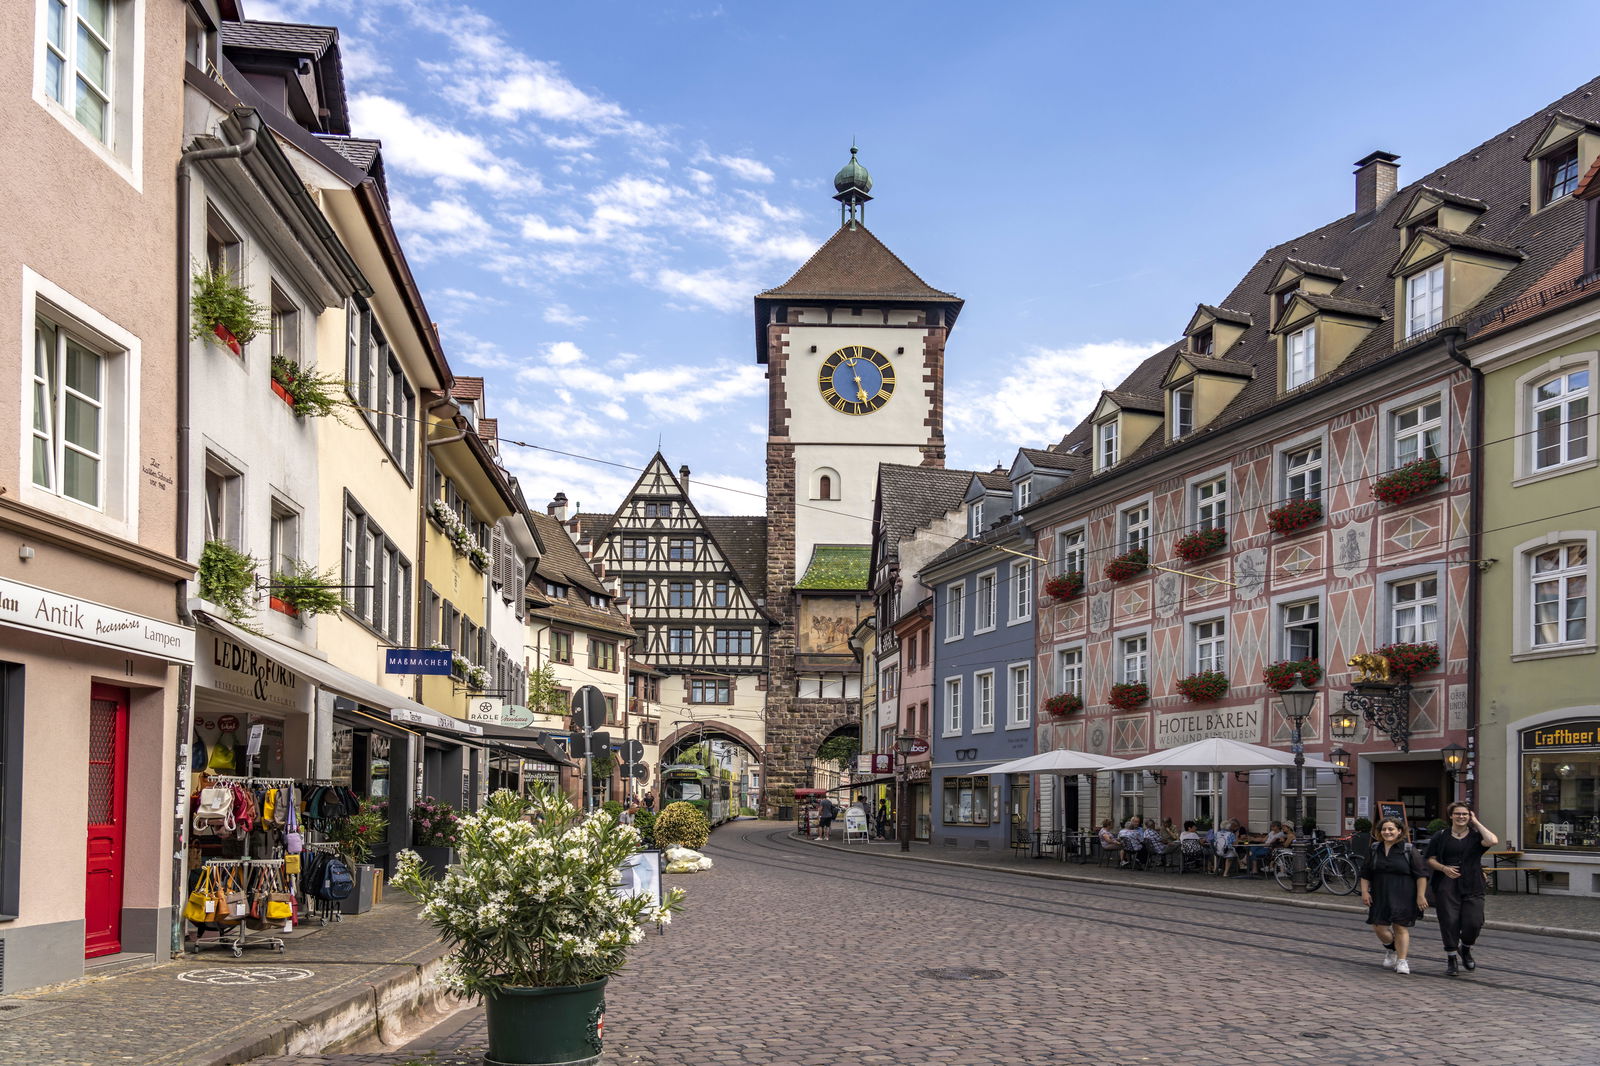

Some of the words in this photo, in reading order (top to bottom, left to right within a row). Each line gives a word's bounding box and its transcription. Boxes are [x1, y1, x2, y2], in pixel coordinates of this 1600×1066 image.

[35, 597, 84, 629] Antik
[96, 619, 139, 634] Accessoires
[144, 626, 181, 648] Lampen
[214, 637, 257, 677] LEDER
[254, 666, 268, 701] &
[266, 658, 295, 688] FORM
[1159, 716, 1203, 734] HOTEL
[1206, 710, 1258, 731] BÄREN
[1535, 729, 1594, 746] Craftbeer
